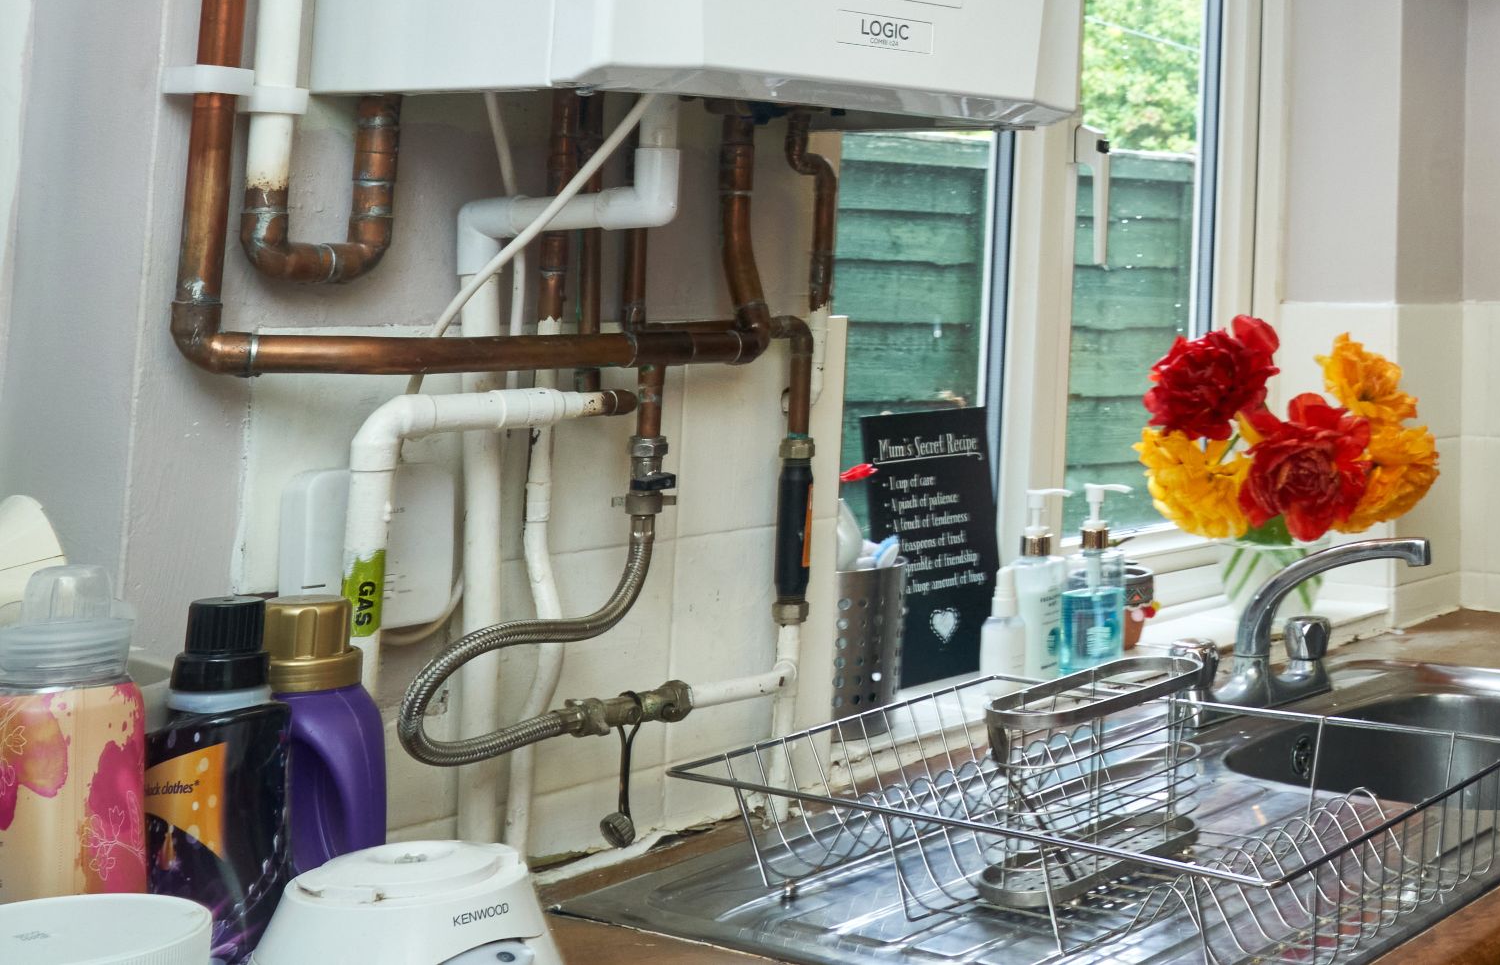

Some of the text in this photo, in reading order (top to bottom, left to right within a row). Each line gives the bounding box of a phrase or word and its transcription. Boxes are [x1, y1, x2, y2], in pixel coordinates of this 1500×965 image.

[861, 18, 910, 41] LOGIC
[869, 37, 888, 46] COMBI
[878, 433, 979, 461] Mum's Secret Recipe
[895, 478, 909, 493] cup
[910, 474, 919, 487] of
[919, 475, 936, 487] care
[898, 494, 918, 515] pinch
[919, 493, 928, 507] of
[928, 492, 960, 511] patience
[900, 515, 921, 531] touch
[922, 514, 930, 528] of
[931, 510, 970, 527] tenderness
[901, 530, 967, 554] teaspoons of trust
[934, 553, 942, 568] of
[943, 549, 979, 566] friendship
[912, 579, 930, 595] huge
[931, 572, 958, 590] amount
[959, 570, 968, 584] of
[968, 568, 987, 585] hugs
[354, 580, 376, 627] GAS
[452, 902, 510, 927] KENWOOD
